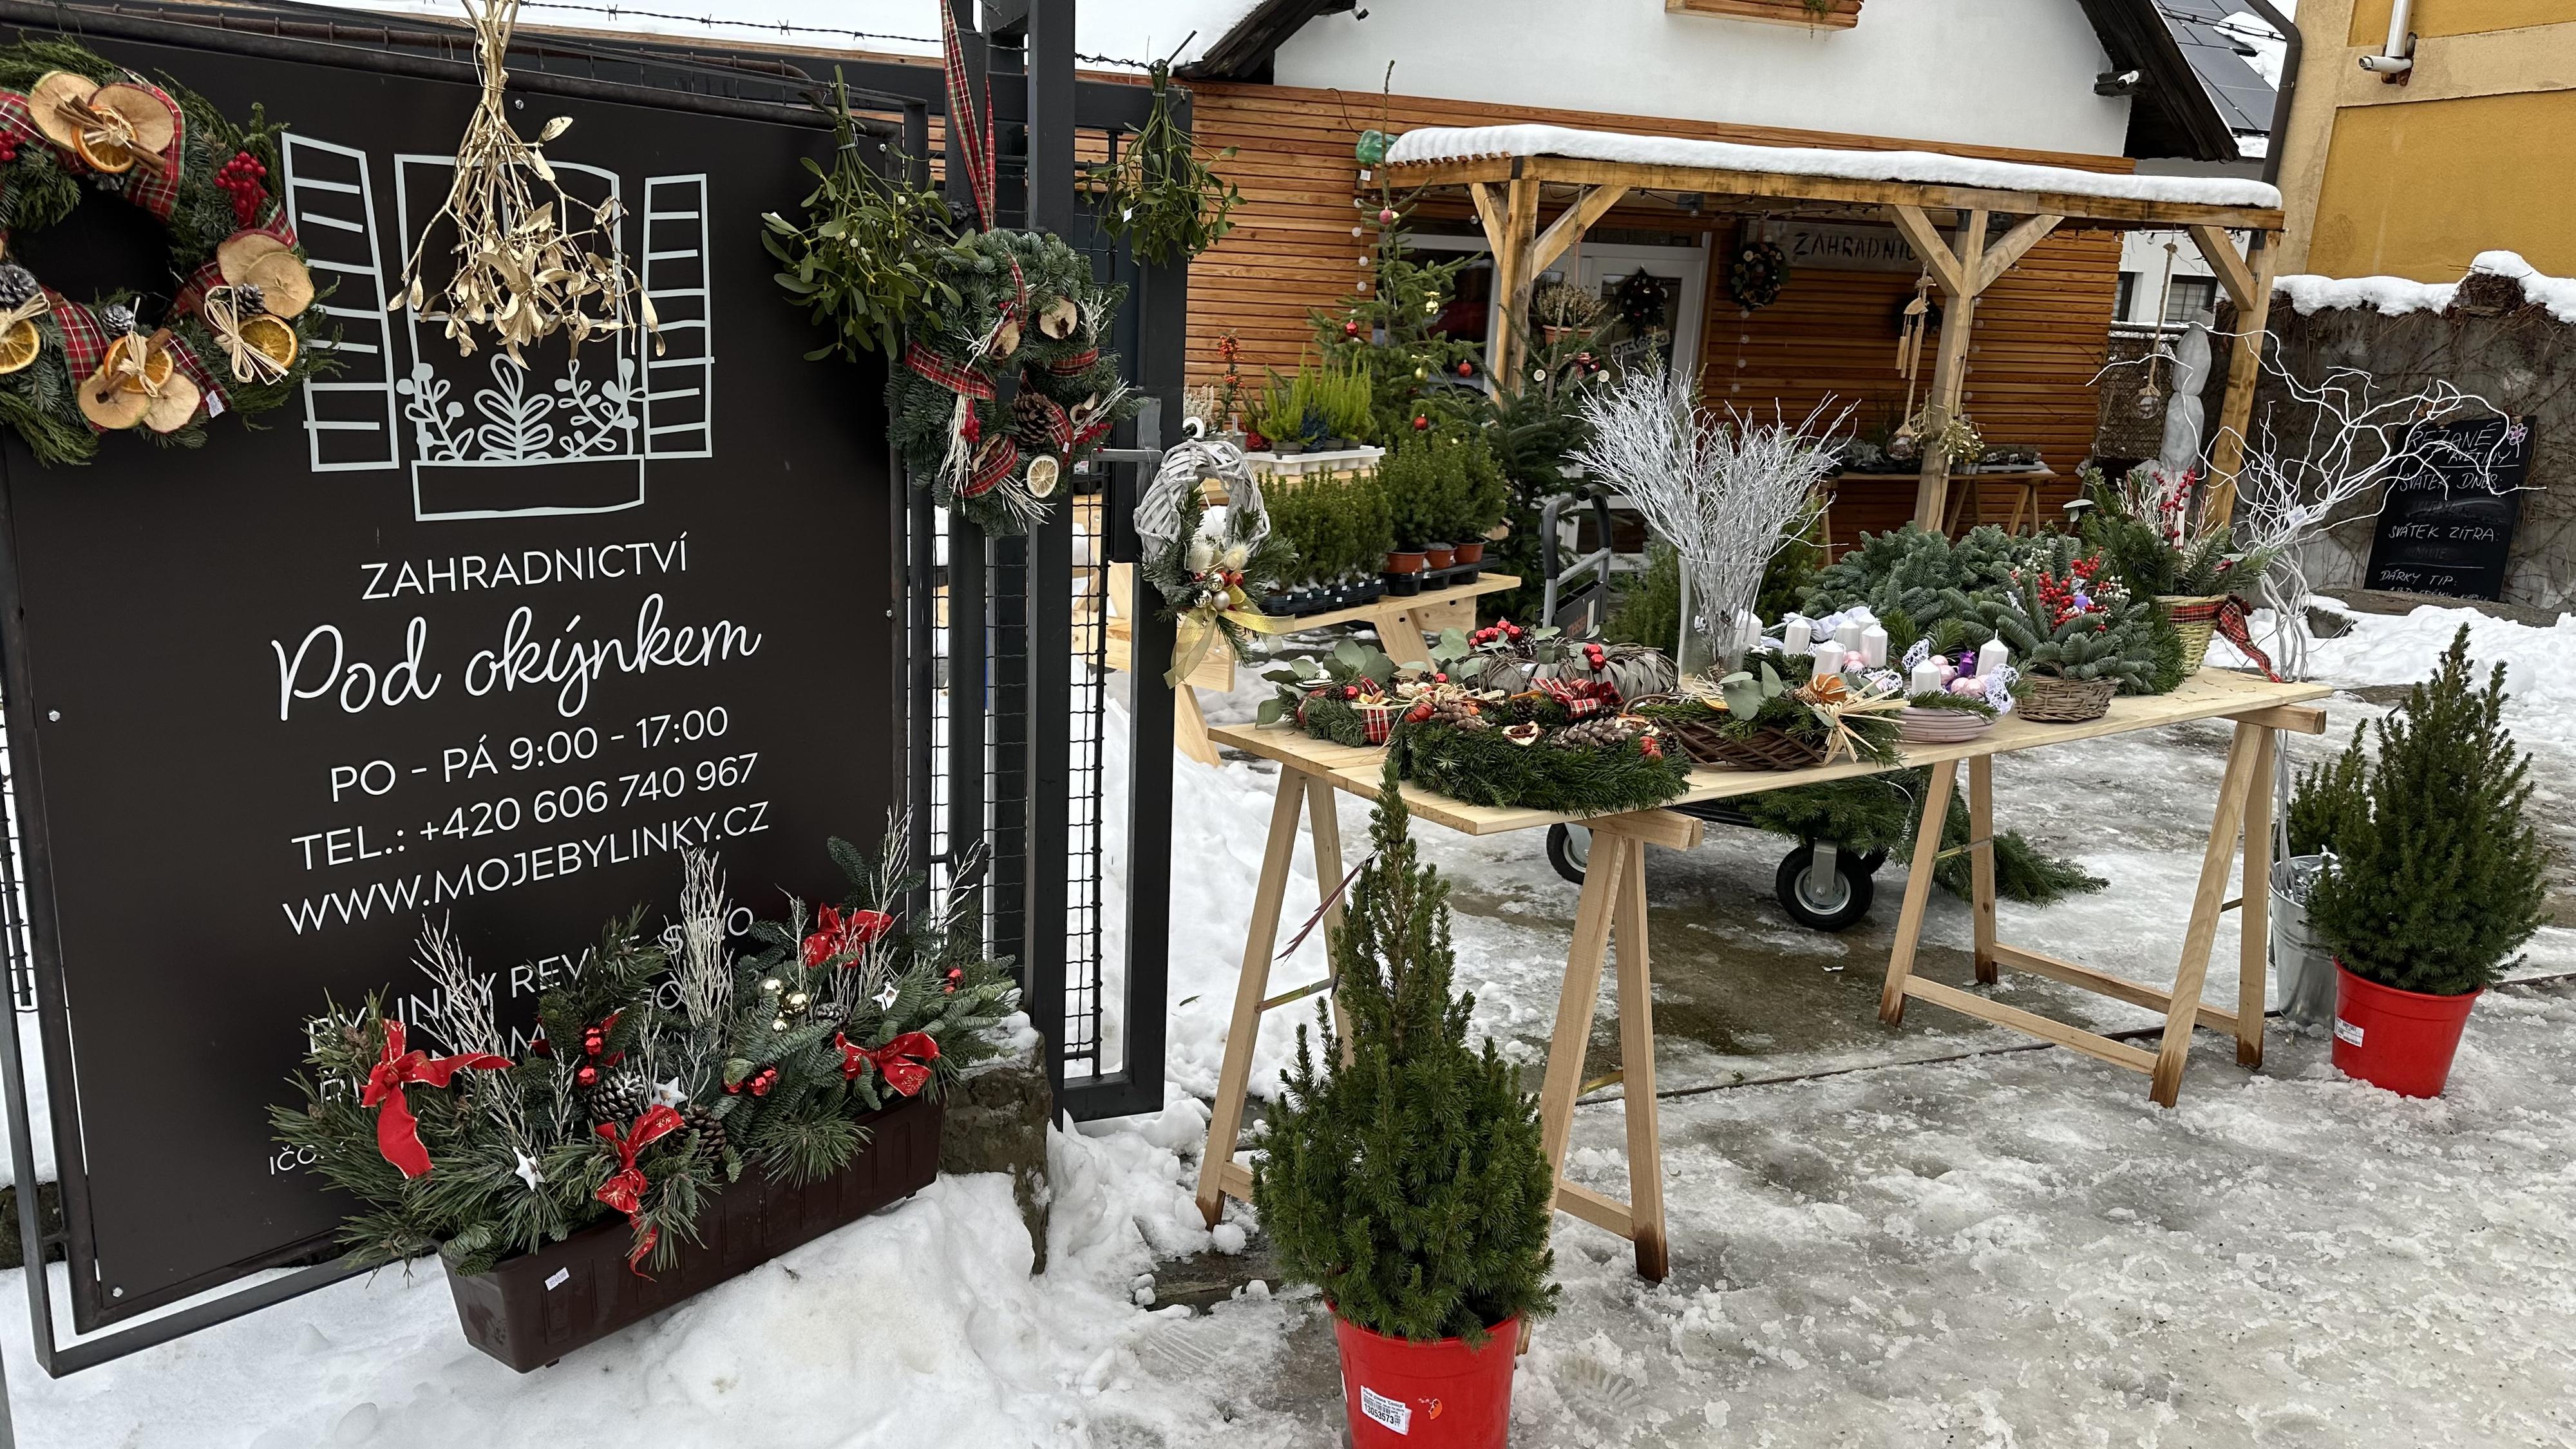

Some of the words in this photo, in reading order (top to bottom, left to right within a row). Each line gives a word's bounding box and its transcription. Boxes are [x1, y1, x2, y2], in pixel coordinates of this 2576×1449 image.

[2400, 470, 2450, 491] SVÁTEK
[361, 531, 687, 600] ZAHRADNICTVÍ
[2389, 523, 2439, 538] SVÁTEK
[2450, 526, 2500, 542] ZÍTRA:
[2379, 569, 2421, 584] DÁRKY
[272, 617, 441, 721] Pod
[466, 593, 762, 717] okýnkem
[330, 761, 395, 802] PO
[444, 734, 498, 782] PÁ
[510, 727, 598, 770] 9:00
[636, 706, 728, 748] 17:00
[292, 826, 404, 870] TEL.:
[420, 797, 520, 841] +420
[534, 781, 608, 823] 606
[618, 767, 684, 807] 740
[696, 753, 758, 791] 967
[282, 800, 770, 935] WWW.MOJEBYLINKY.CZ
[308, 972, 497, 1054] BYINKY
